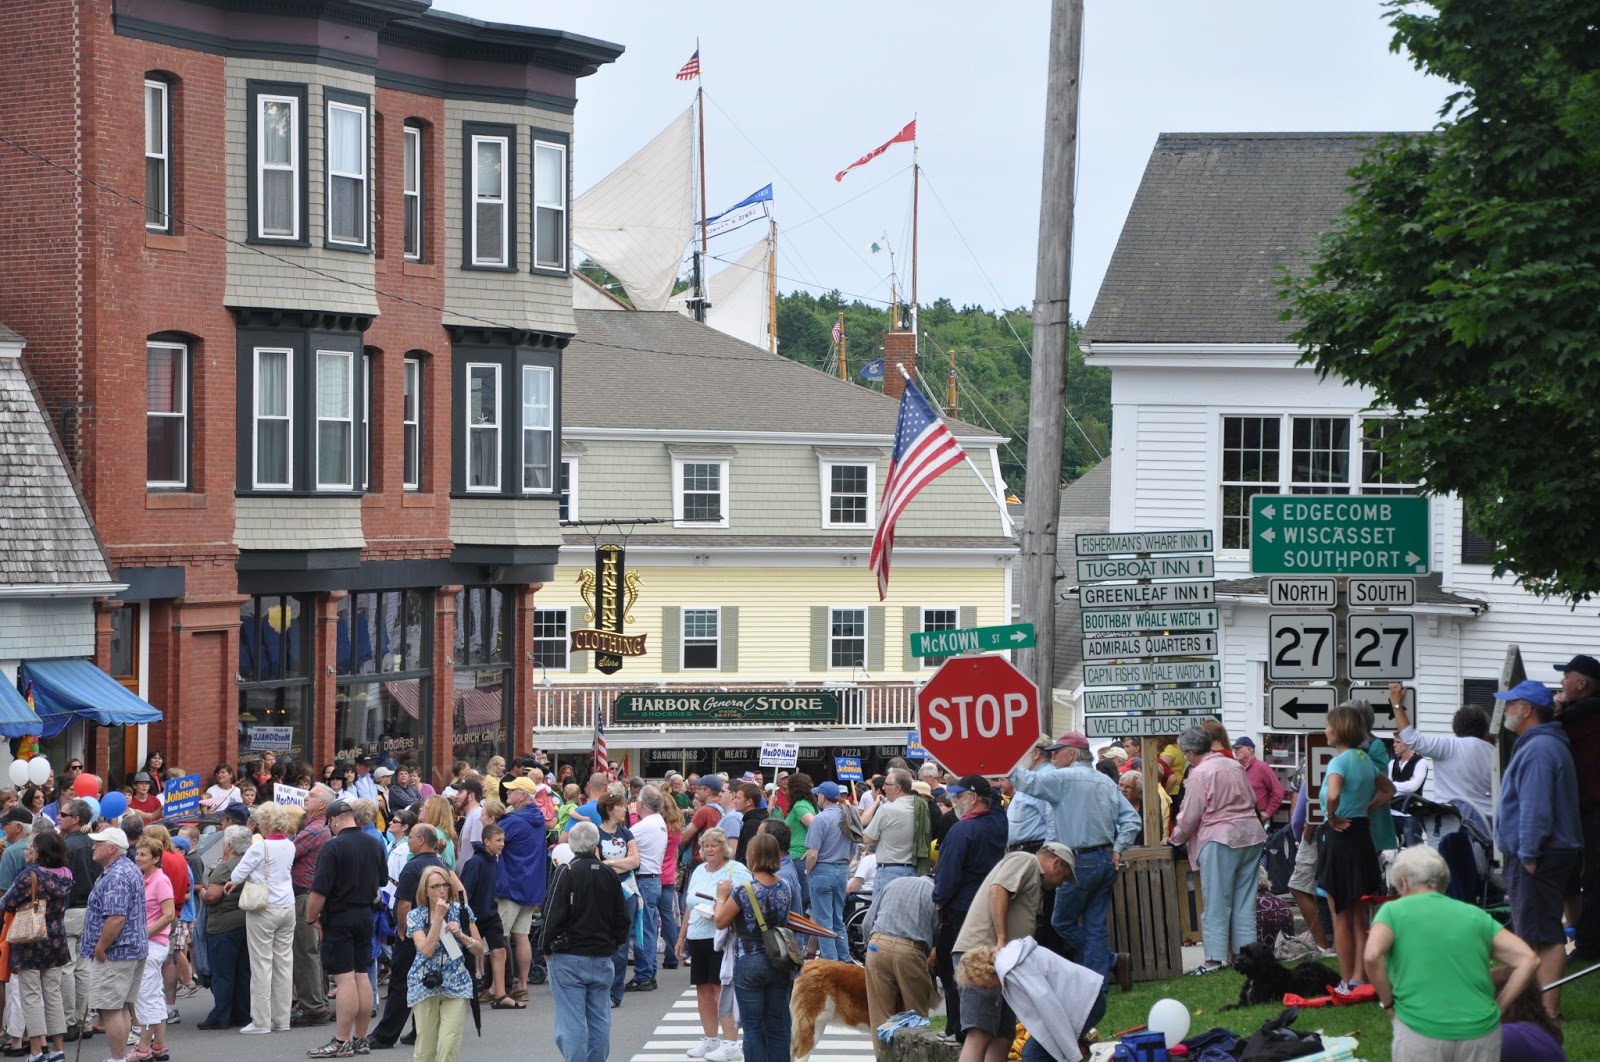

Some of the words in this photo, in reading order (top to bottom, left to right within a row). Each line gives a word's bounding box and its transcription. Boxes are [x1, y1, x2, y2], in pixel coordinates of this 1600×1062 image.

[1283, 503, 1392, 521] EDGECOMB
[1082, 535, 1142, 552] FISHERMAN'S
[1144, 534, 1178, 550] WHARF
[1180, 534, 1198, 549] INN
[1283, 527, 1396, 544] WISCASSET
[1283, 550, 1400, 568] SOUTHPORT
[1086, 561, 1157, 578] TUGBOAT
[1162, 560, 1190, 575] INN
[1085, 586, 1168, 604] GREENLEAF
[1174, 586, 1198, 600] INN
[1278, 583, 1328, 601] NORTH
[1356, 583, 1406, 601] SOUTH
[1085, 613, 1132, 629] BOOTHBAY
[1135, 612, 1168, 628] WHALE
[1169, 611, 1201, 627] WATCH
[575, 631, 642, 655] CLOTHING
[920, 631, 979, 653] McKOWN
[991, 633, 1000, 644] ST
[1088, 639, 1141, 655] ADMIRALS
[1145, 637, 1201, 654] QUARTERS
[1275, 627, 1329, 666] 27
[1354, 627, 1409, 667] 27
[598, 655, 619, 667] Store
[1087, 668, 1113, 684] CAP'N
[1115, 667, 1140, 683] FISH'S
[1142, 665, 1173, 681] WHALE
[1175, 664, 1205, 680] WATCH
[629, 697, 701, 711] HARBOR
[702, 696, 755, 711] General
[755, 696, 824, 711] STORE
[1088, 692, 1157, 709] WATERFRONT
[1162, 691, 1207, 707] PARKING
[928, 692, 1029, 742] STOP
[1093, 718, 1139, 734] WELCH
[1144, 717, 1186, 734] HOUSE
[383, 737, 414, 751] DOCKERS
[452, 732, 480, 745] OOLRICH
[652, 749, 698, 760] SANDWICHES
[724, 749, 748, 759] MEATS
[762, 748, 797, 758] MacDONALD
[798, 748, 819, 758] AKERY
[841, 748, 861, 757] PIZZA
[881, 746, 899, 756] BEER
[179, 778, 194, 789] Chris
[165, 787, 199, 803] Johnson
[276, 794, 303, 806] MacDONAL
[179, 801, 195, 809] Senator
